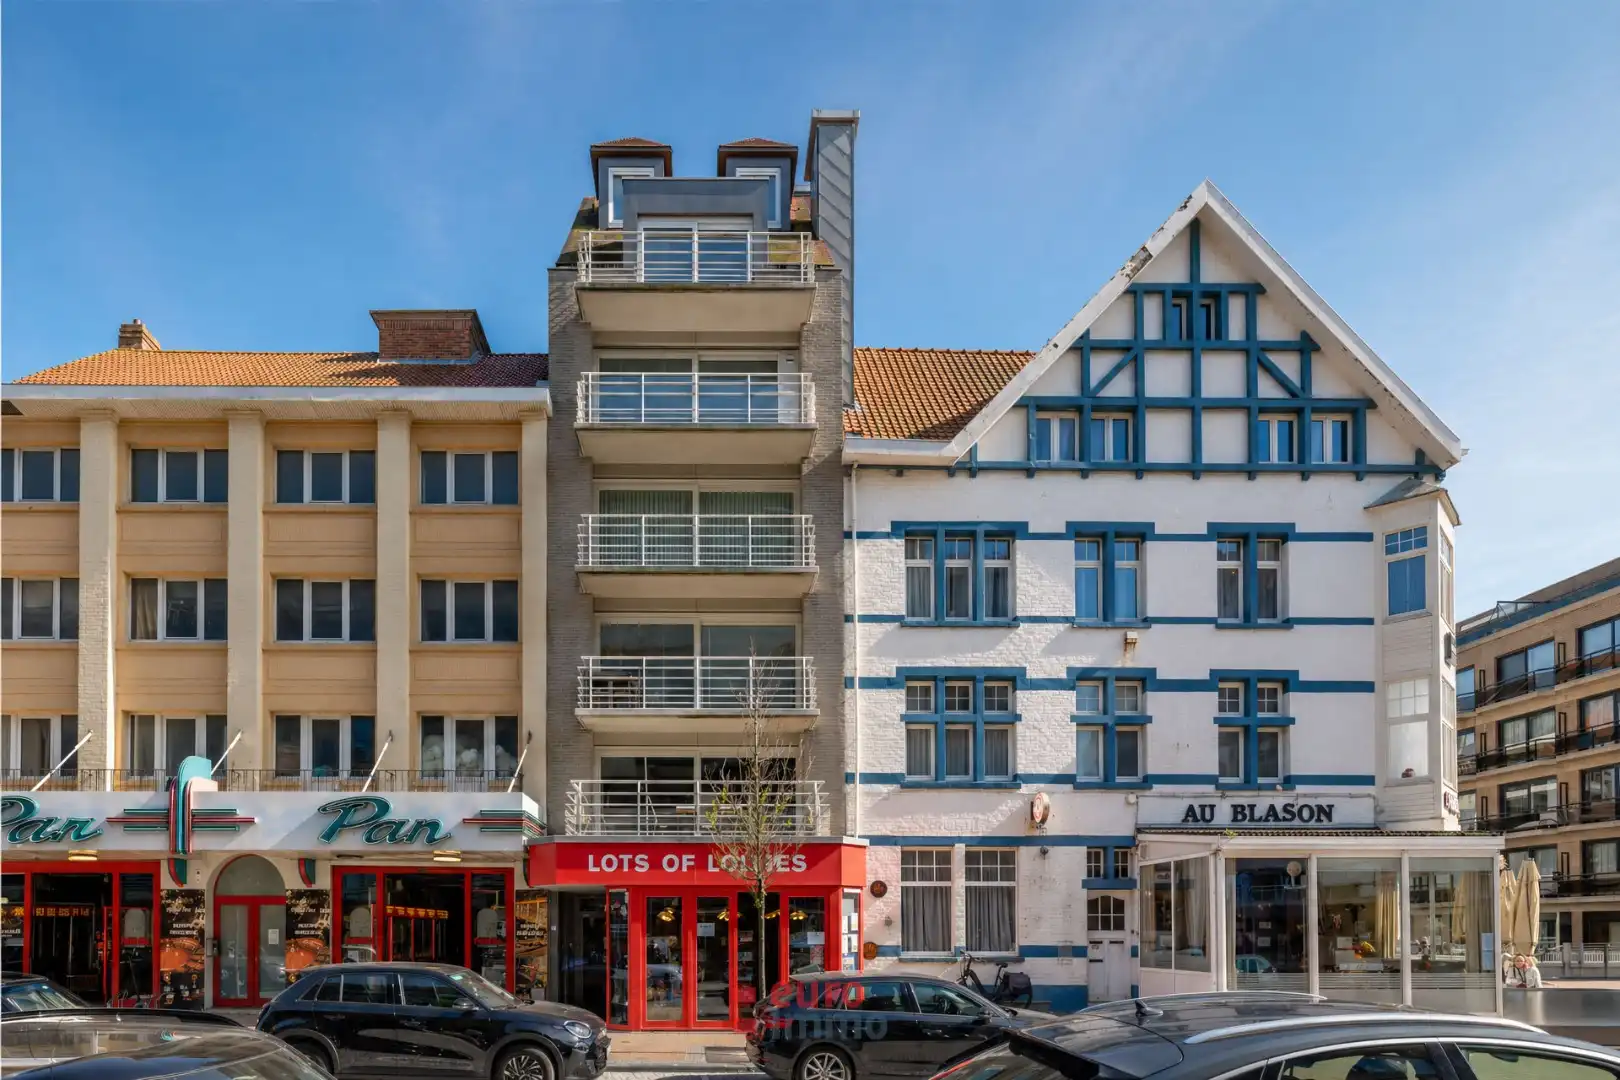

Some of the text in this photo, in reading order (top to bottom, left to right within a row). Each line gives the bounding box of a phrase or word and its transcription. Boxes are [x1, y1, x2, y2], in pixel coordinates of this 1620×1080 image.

[317, 796, 452, 845] Pan
[1181, 803, 1335, 823] AU BLASON
[588, 854, 650, 872] LOTS
[662, 854, 696, 872] OF
